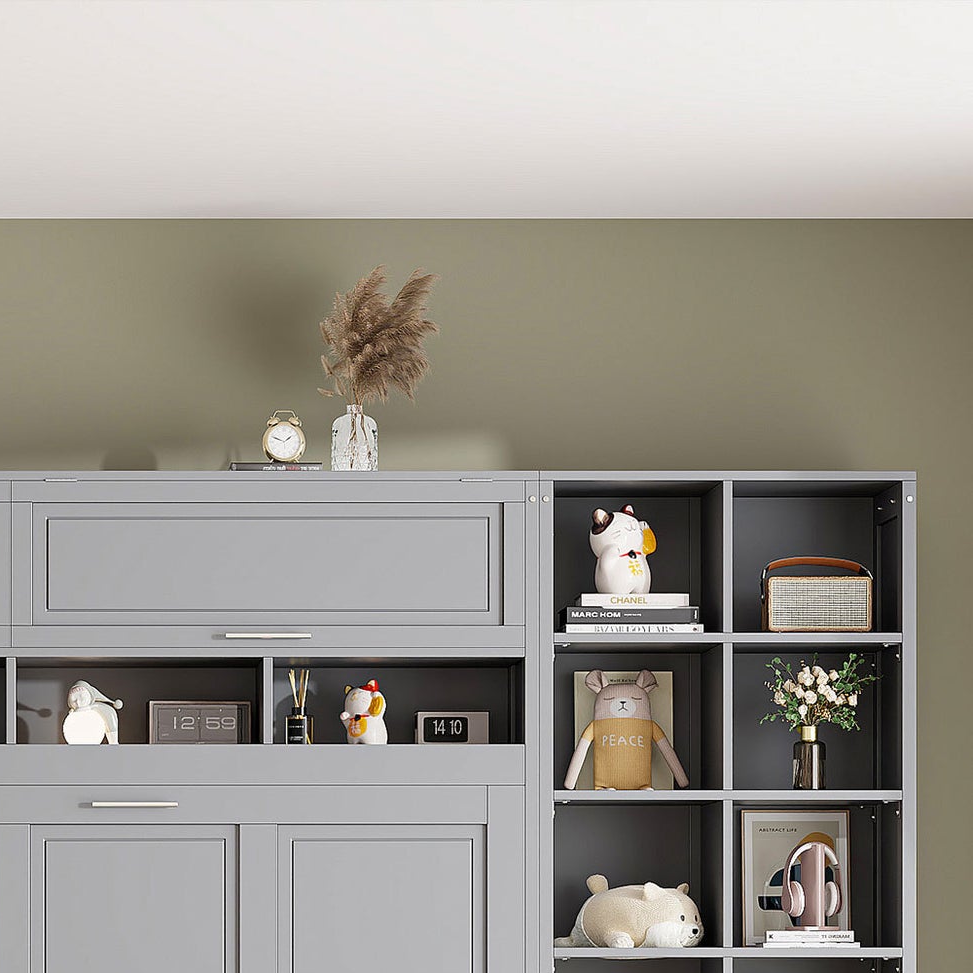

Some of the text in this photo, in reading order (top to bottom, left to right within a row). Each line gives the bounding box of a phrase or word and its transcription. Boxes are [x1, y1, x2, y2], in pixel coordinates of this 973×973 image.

[610, 596, 648, 605] CHANEL
[173, 716, 236, 730] 12 59
[432, 719, 462, 735] 14 10
[602, 734, 645, 748] PEACE
